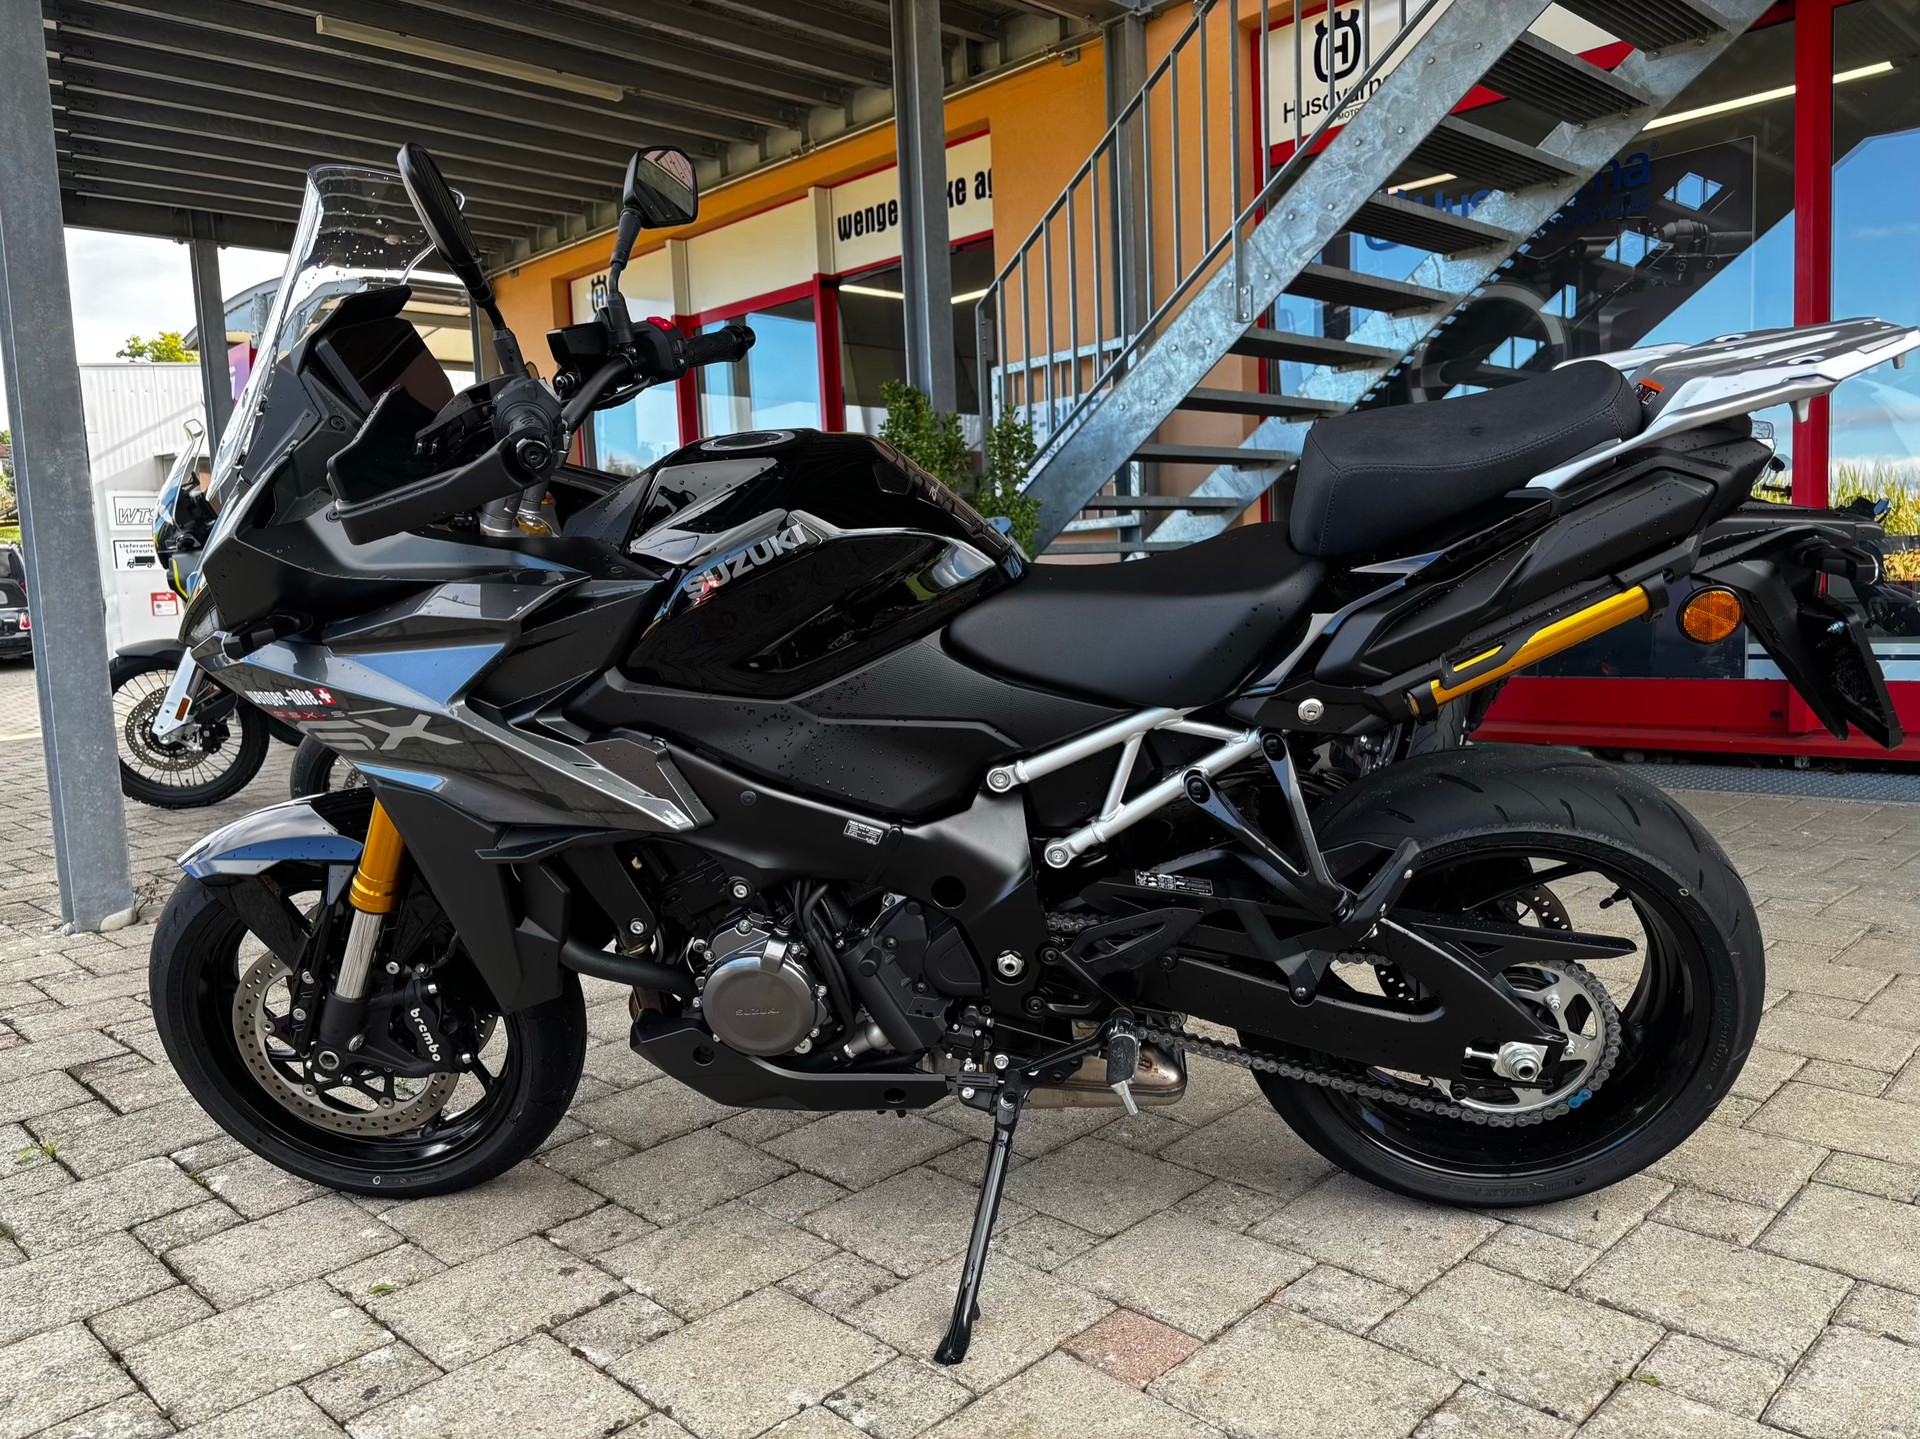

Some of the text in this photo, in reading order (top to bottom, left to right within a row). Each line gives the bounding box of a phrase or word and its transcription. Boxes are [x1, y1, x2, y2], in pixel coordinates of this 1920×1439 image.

[837, 199, 899, 242] wenge
[683, 523, 807, 600] SUZUKI
[410, 1007, 441, 1062] brembo
